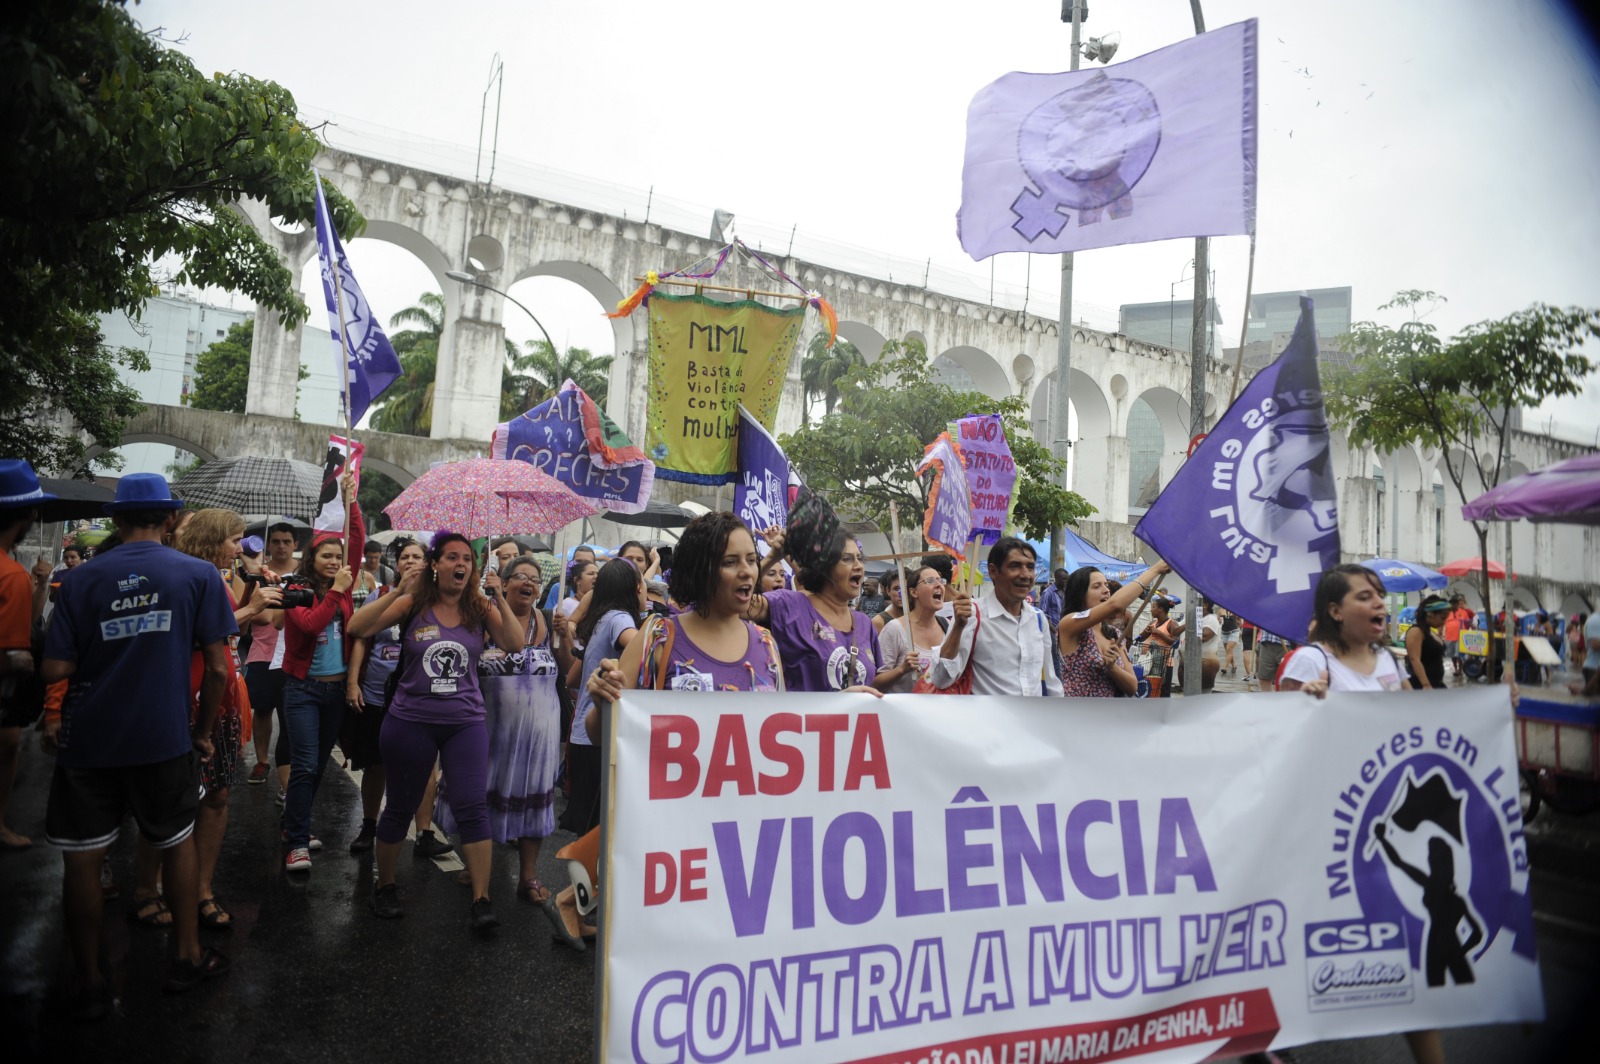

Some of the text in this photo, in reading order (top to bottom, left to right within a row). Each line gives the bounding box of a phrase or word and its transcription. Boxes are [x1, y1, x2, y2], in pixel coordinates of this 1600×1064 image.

[355, 325, 386, 364] Lut
[689, 321, 748, 354] MML
[687, 361, 731, 379] Basta
[960, 418, 998, 442] NÃO
[960, 449, 1014, 473] STATUTO
[603, 492, 623, 501] MML
[976, 475, 992, 490] DO
[983, 515, 1002, 529] MML
[111, 592, 159, 612] CAIXA
[104, 612, 170, 637] STAFF
[648, 711, 892, 801] BASTA
[1325, 725, 1529, 900] Mulheres em Luta
[643, 785, 1218, 938] DE VIOLÊNCIA
[1308, 921, 1400, 954] CSP
[631, 898, 1287, 1064] CONTRA A MULHER
[1039, 1030, 1110, 1064] MARIA
[1112, 1023, 1141, 1053] DA
[1142, 1007, 1214, 1046] PENHA,
[1216, 997, 1246, 1031] JÁ!
